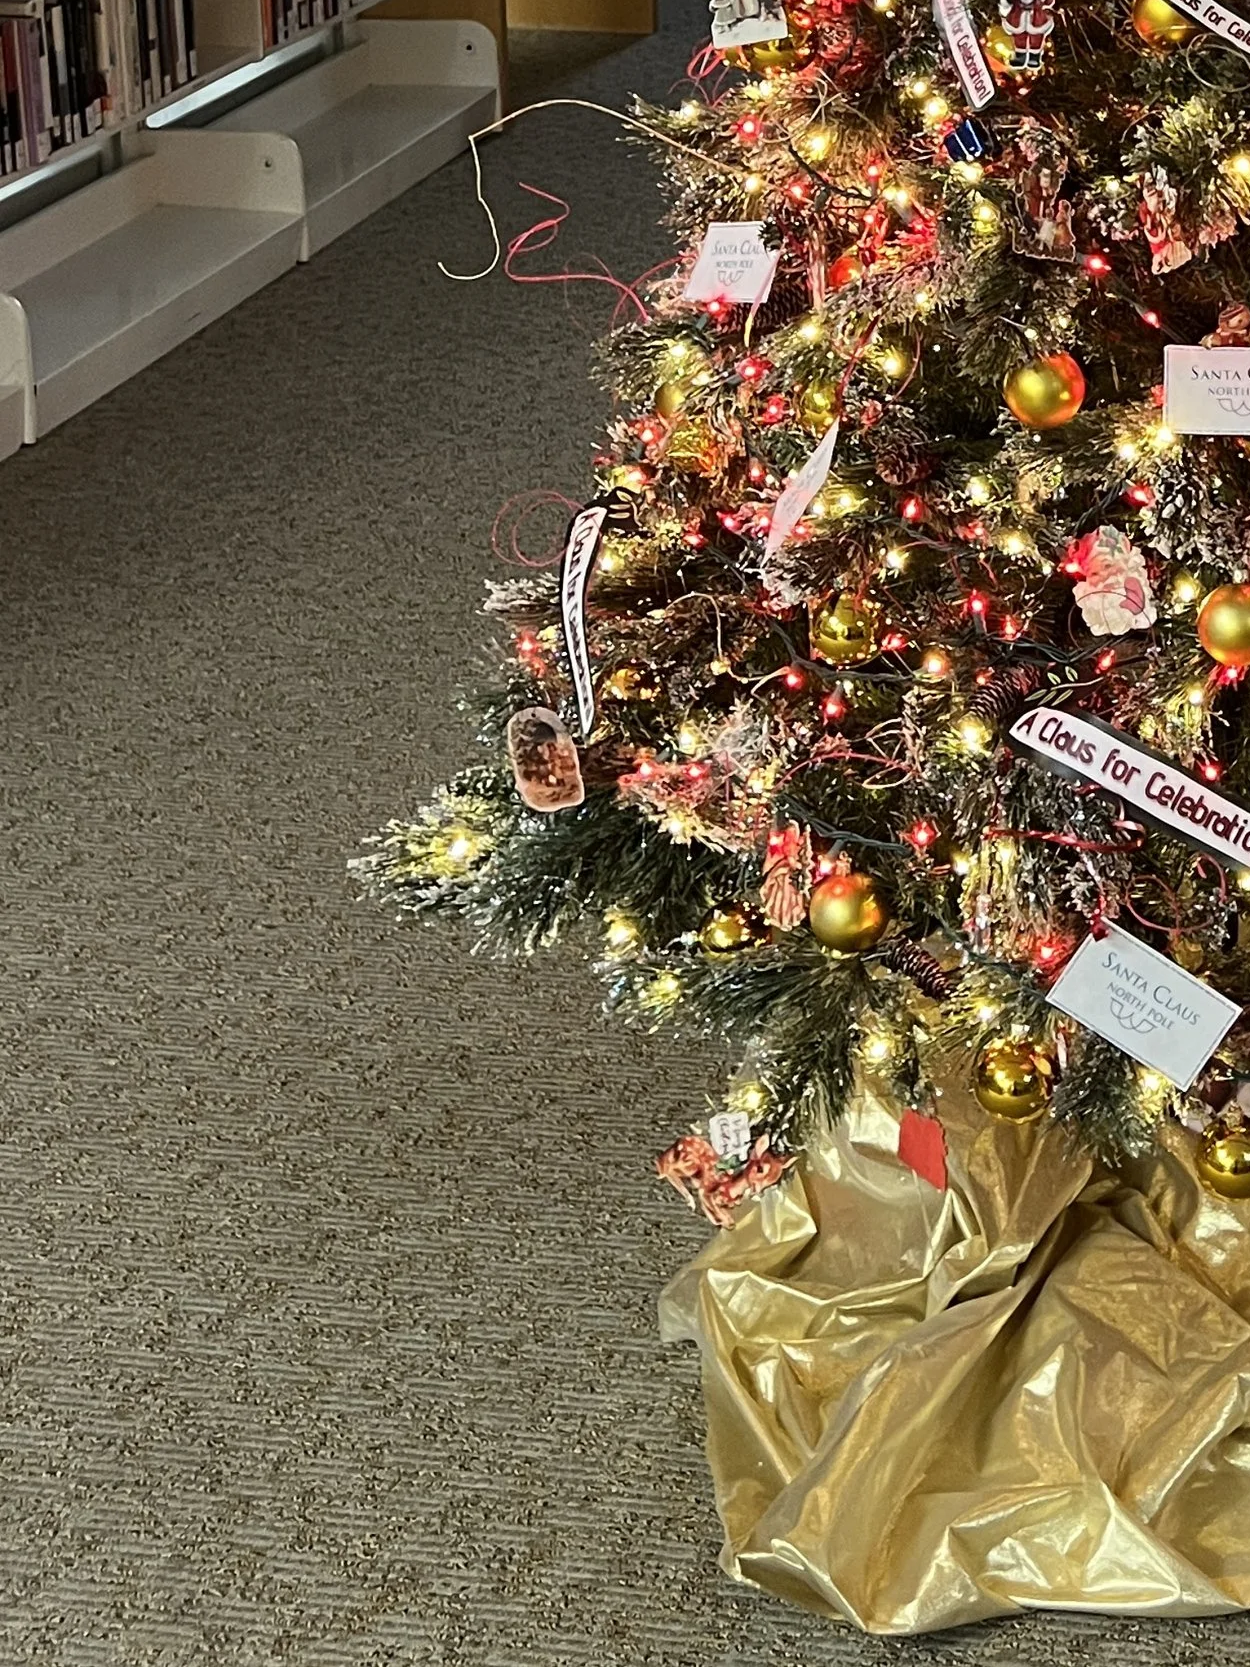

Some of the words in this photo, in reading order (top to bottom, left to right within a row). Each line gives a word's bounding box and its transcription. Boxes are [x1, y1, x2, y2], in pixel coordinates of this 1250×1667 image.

[1203, 5, 1227, 26] for
[712, 241, 737, 255] SANTA
[1191, 365, 1241, 380] SANTA
[1208, 388, 1250, 397] NORTH
[1017, 713, 1038, 735] A
[1038, 717, 1096, 764] Claus
[1101, 749, 1141, 785] for
[1102, 952, 1148, 993] SANTA
[1153, 985, 1200, 1026] CLAUS
[1107, 983, 1146, 1011] NORTH
[1149, 1009, 1175, 1030] POLE
